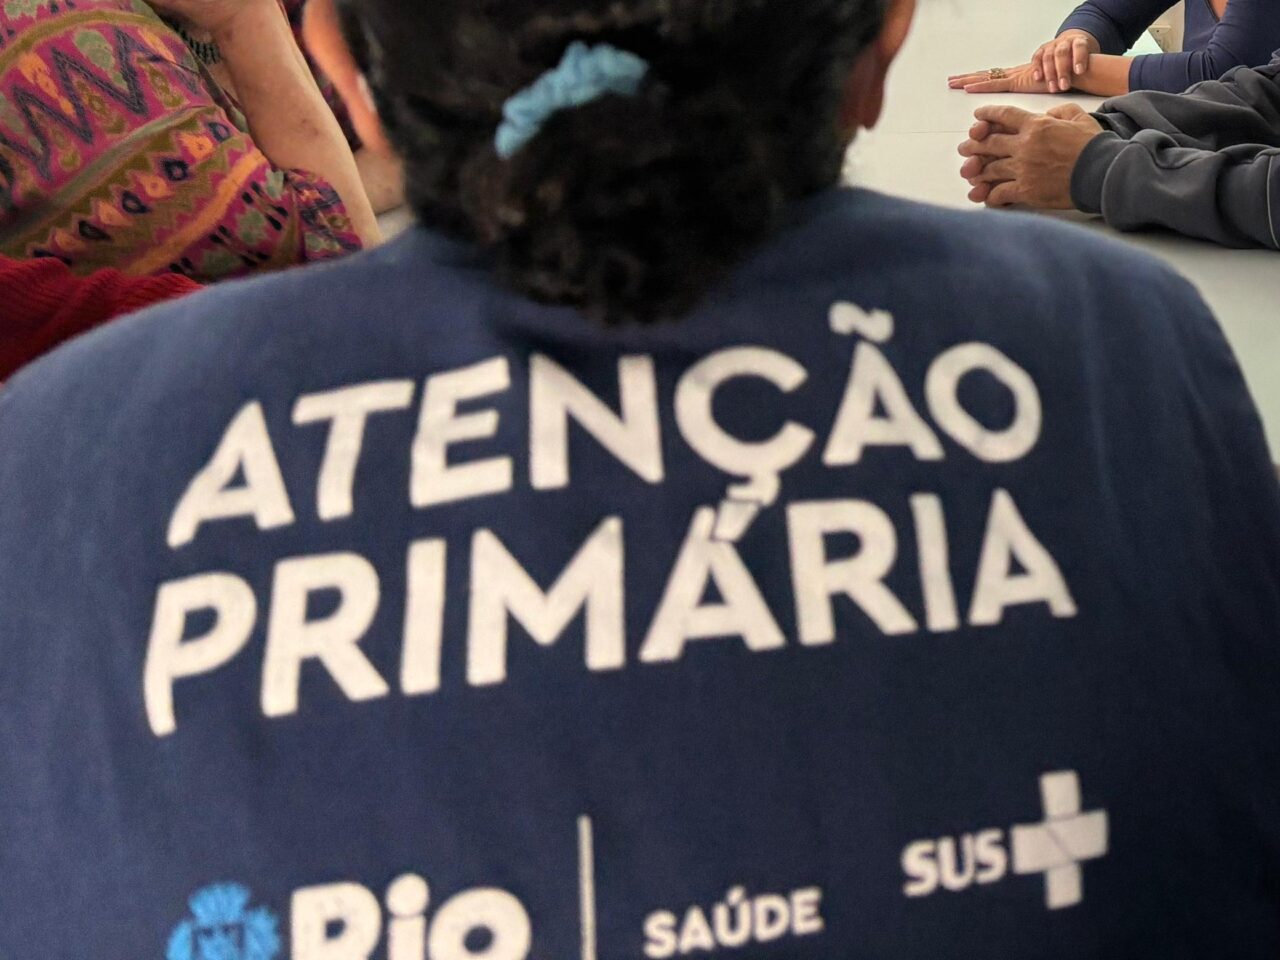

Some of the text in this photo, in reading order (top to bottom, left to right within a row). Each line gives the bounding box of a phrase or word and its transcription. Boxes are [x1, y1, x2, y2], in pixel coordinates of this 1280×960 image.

[167, 302, 1042, 548] ATENÇÃO
[142, 487, 1077, 735] PRIMÁRIA
[642, 885, 824, 959] SAÚDE
[902, 828, 1007, 897] SUS
